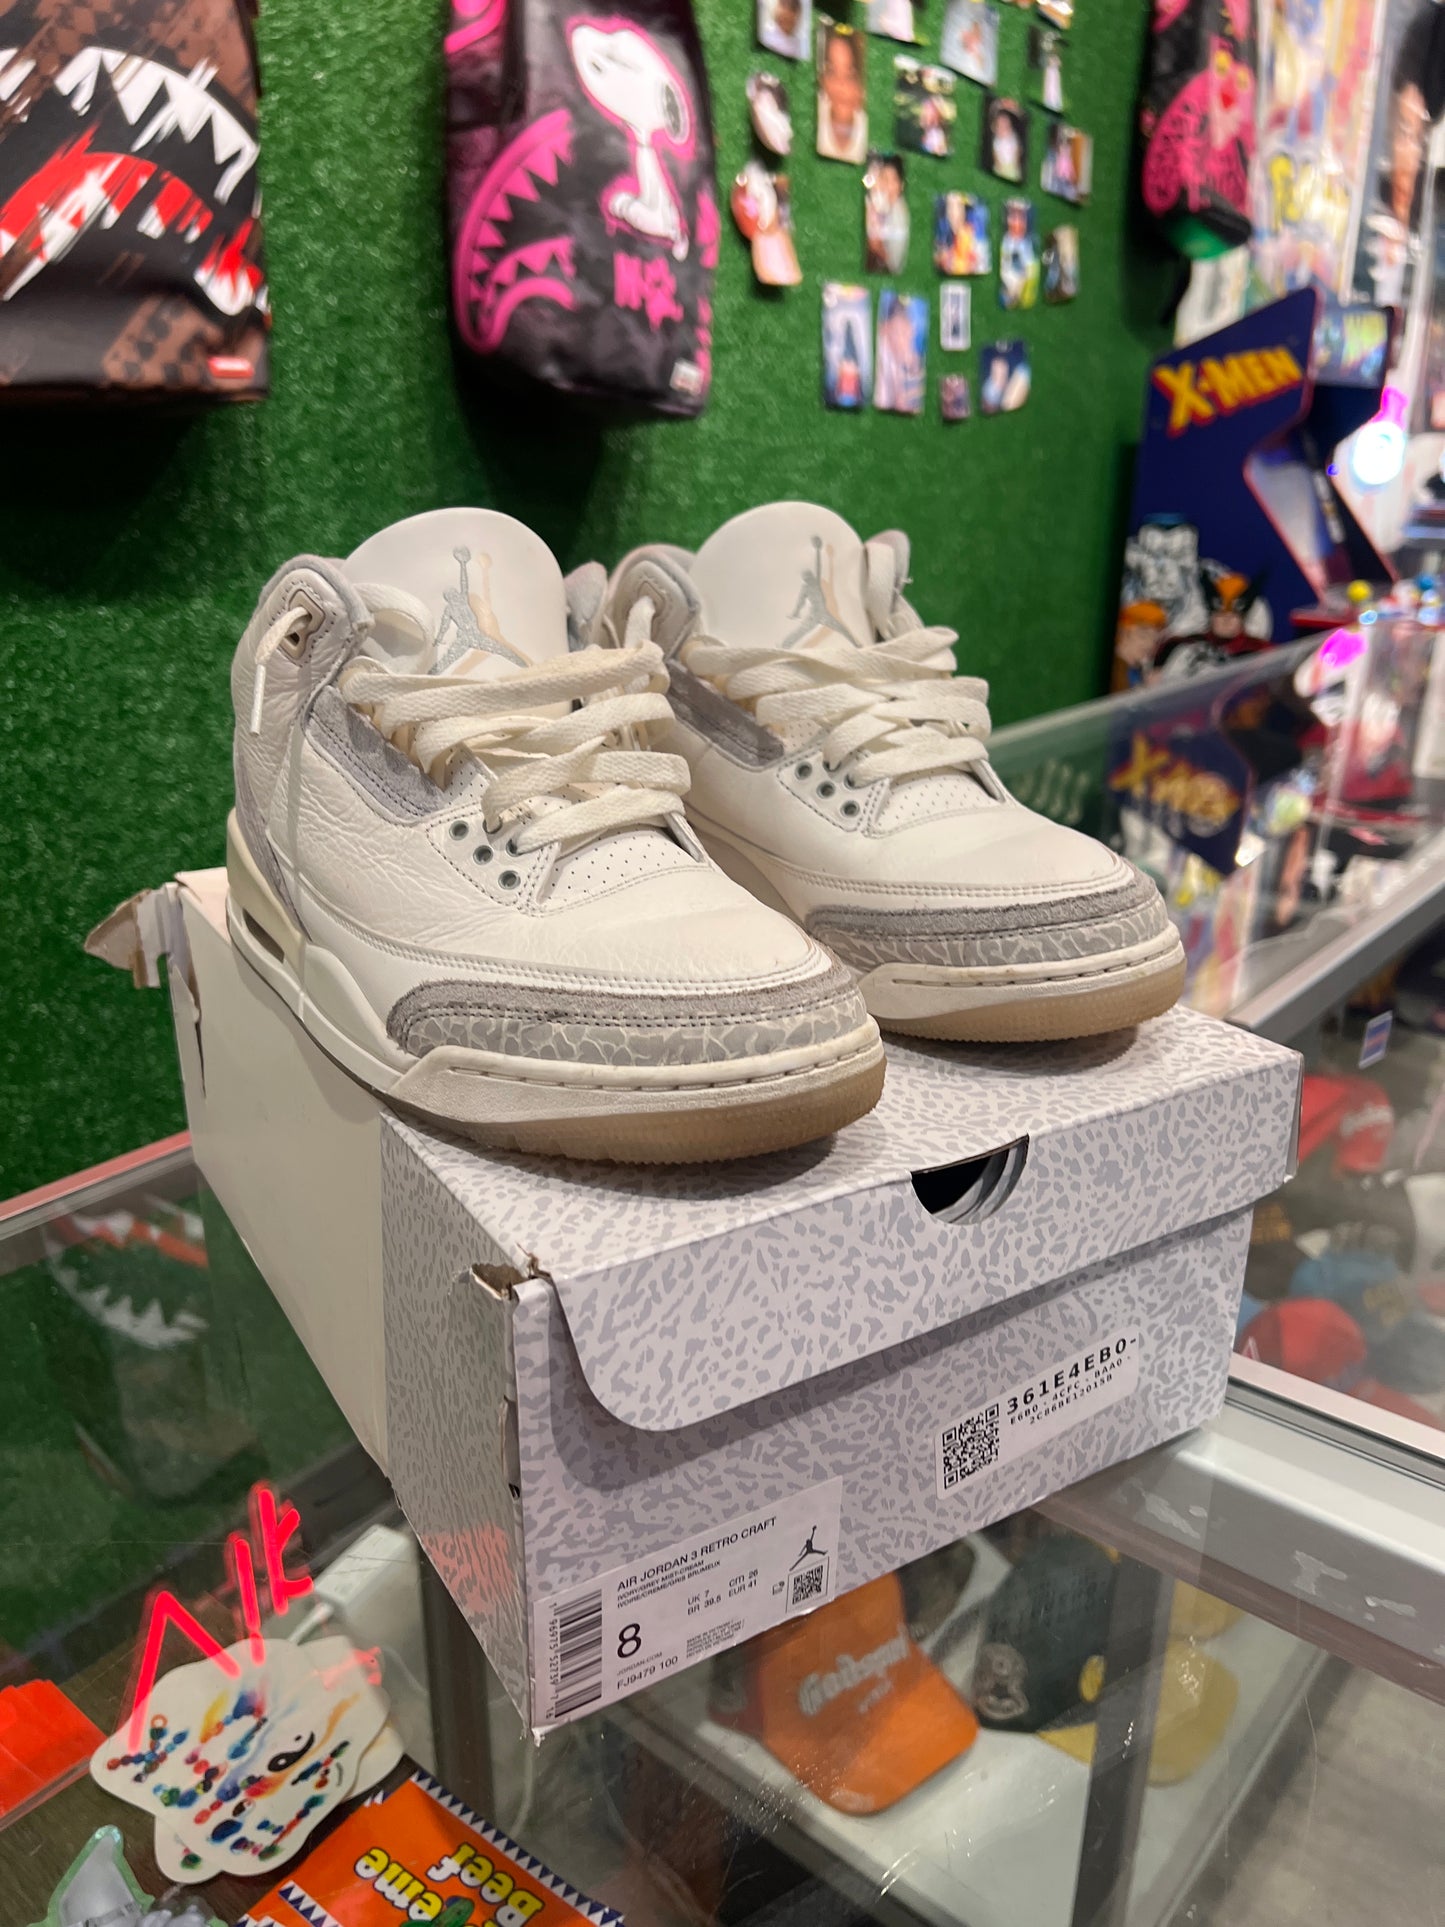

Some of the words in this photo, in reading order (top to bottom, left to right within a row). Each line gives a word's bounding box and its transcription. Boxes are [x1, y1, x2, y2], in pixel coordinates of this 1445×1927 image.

[1151, 344, 1302, 438] X-MEN
[1006, 1337, 1137, 1416] 361E4EB0-
[617, 1575, 638, 1592] AIR
[640, 1553, 689, 1582] JORDAN
[691, 1550, 698, 1561] 3
[700, 1533, 739, 1557] RETRO
[741, 1516, 777, 1540] CRAFT
[687, 1594, 701, 1606] UK
[704, 1589, 710, 1598] 7
[728, 1574, 745, 1588] cm
[748, 1569, 759, 1580] 26
[687, 1604, 700, 1616] BR
[728, 1583, 746, 1598] EUR
[747, 1579, 757, 1589] 41
[617, 1623, 641, 1658] 8
[617, 1665, 656, 1690] FJ9479
[660, 1655, 678, 1670] 100
[426, 1842, 546, 1927] Beef
